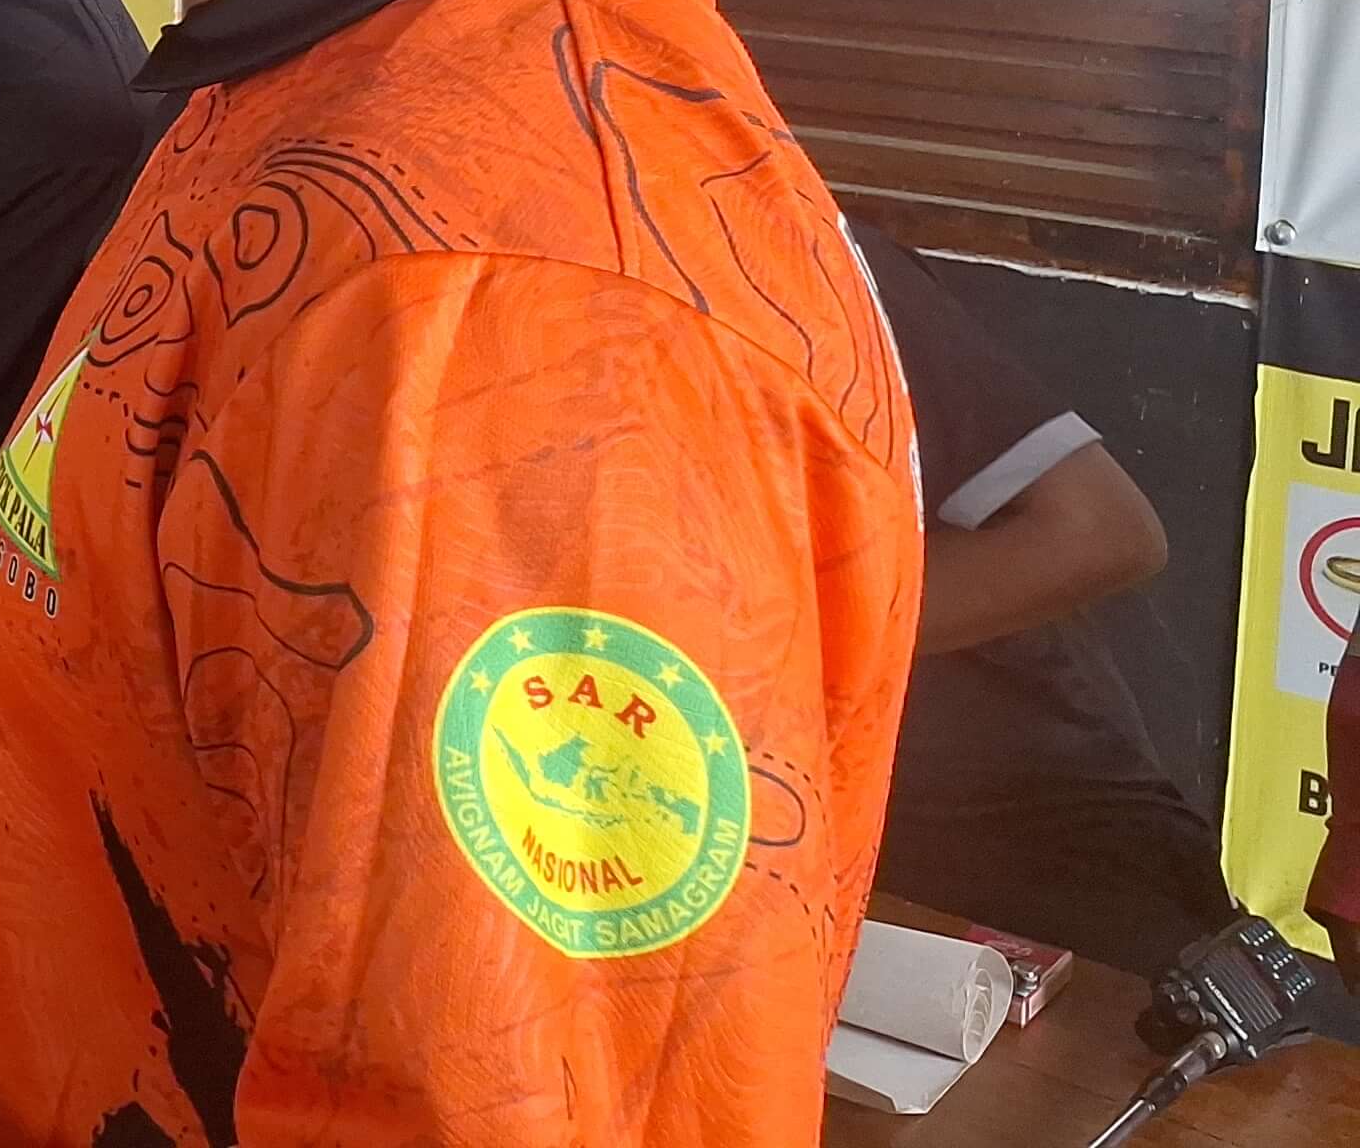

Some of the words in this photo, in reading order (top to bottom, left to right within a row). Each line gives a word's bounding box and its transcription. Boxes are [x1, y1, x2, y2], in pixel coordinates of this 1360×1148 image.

[522, 673, 658, 740] SAR
[442, 744, 525, 899] AVIGNAM
[595, 816, 742, 948] SAMAGRAM
[521, 824, 644, 896] NASIONAL
